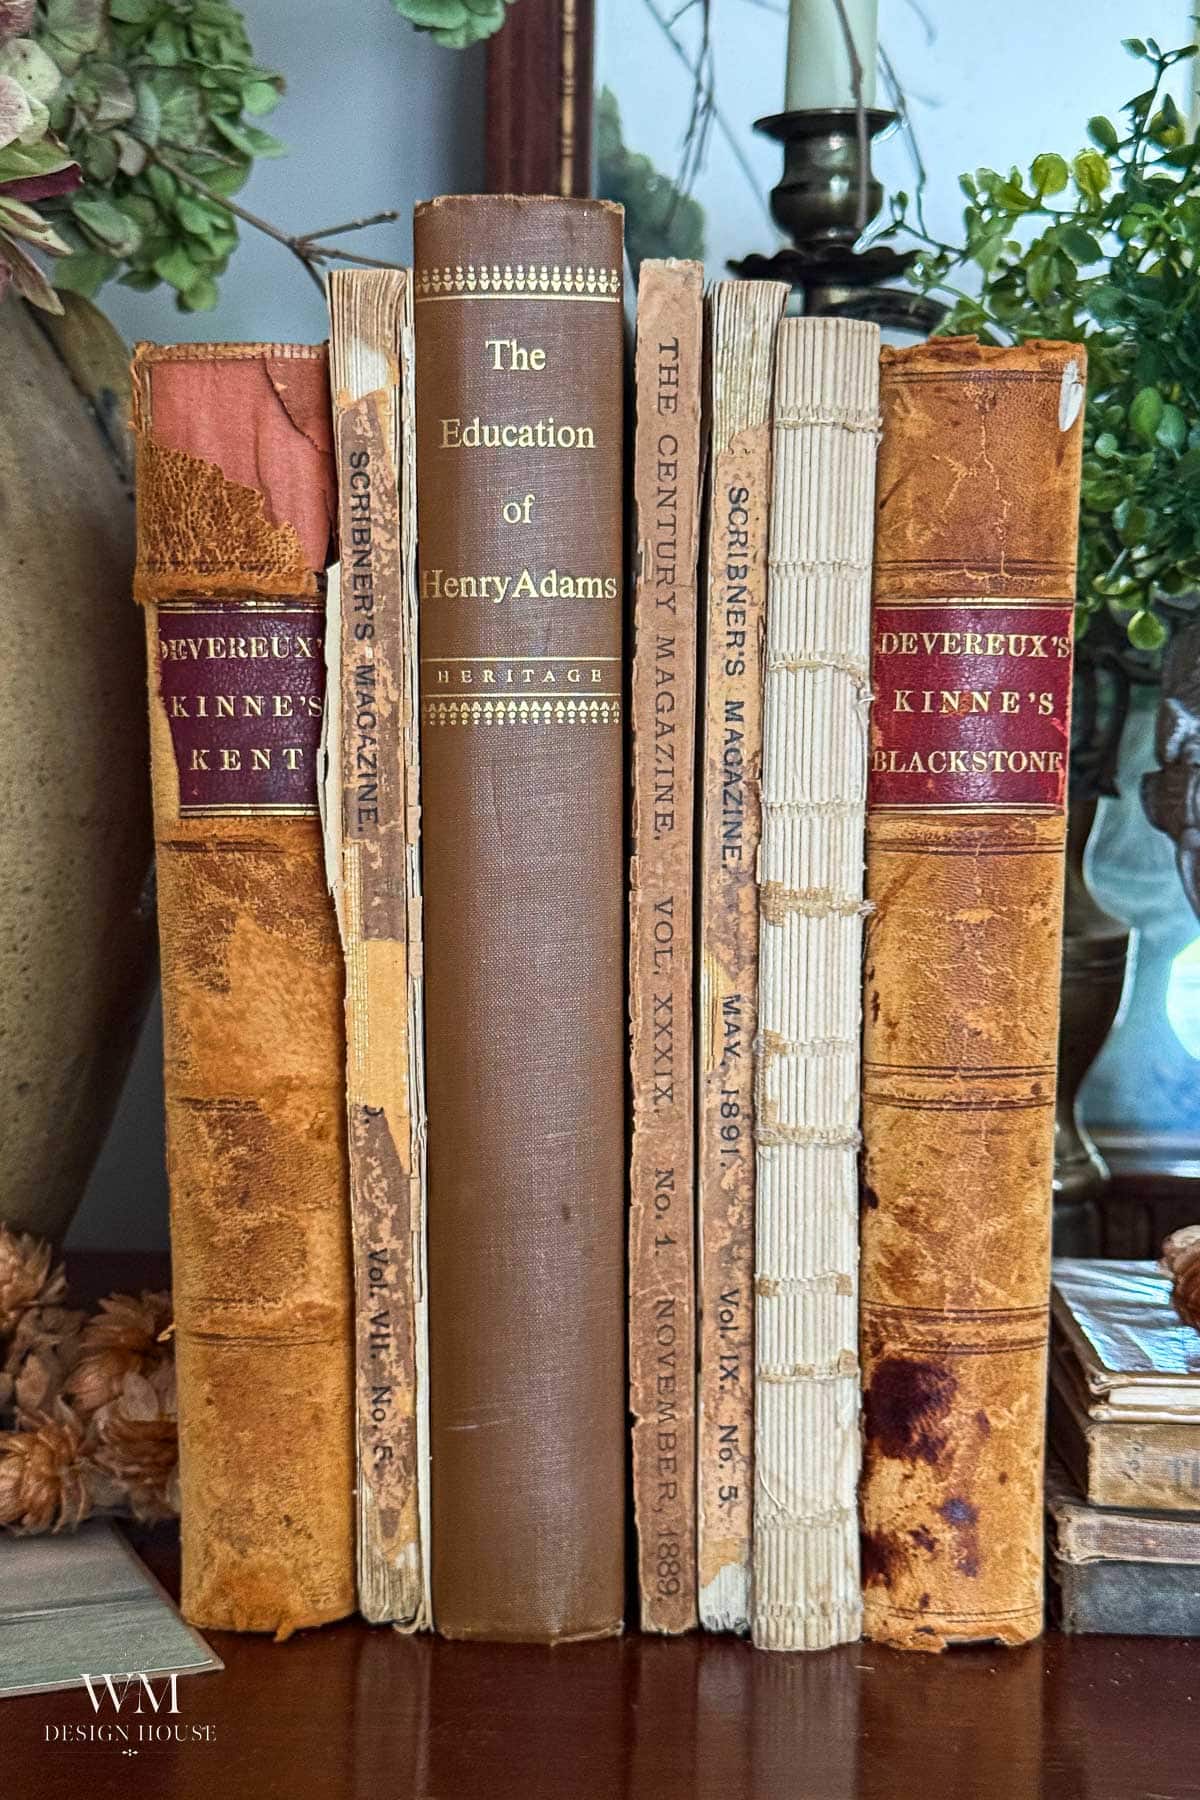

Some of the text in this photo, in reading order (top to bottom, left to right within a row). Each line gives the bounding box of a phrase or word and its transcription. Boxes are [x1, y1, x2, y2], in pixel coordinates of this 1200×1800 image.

[484, 339, 546, 371] The
[656, 336, 679, 417] THE
[440, 418, 596, 449] Education
[502, 494, 535, 524] of
[655, 433, 678, 616] CENTURY
[350, 450, 375, 641] SCRIBNER'S
[422, 569, 617, 603] Henry Adams
[725, 486, 750, 677] SCRIBNER'S
[877, 632, 1071, 658] DEVEREUX'S
[437, 669, 602, 684] HERITAGE
[170, 695, 323, 718] KINNE'S
[893, 690, 1054, 715] KINNE'S
[190, 748, 304, 771] KENT
[355, 664, 379, 832] MAGAZINE.
[653, 635, 675, 841] MAGAZINE.
[871, 751, 1063, 774] BLACKSTONE
[722, 700, 745, 869] MAGAZINE.
[653, 895, 674, 975] VOL.
[653, 993, 674, 1113] XXXIX.
[719, 1088, 741, 1168] 1891.
[654, 1167, 675, 1220] No.
[368, 1247, 389, 1298] Vol.
[719, 1288, 740, 1339] Vol.
[718, 1354, 740, 1391] IX.
[371, 1385, 393, 1430] No.
[652, 1299, 678, 1513] NOVEMBER,
[718, 1424, 739, 1469] No.
